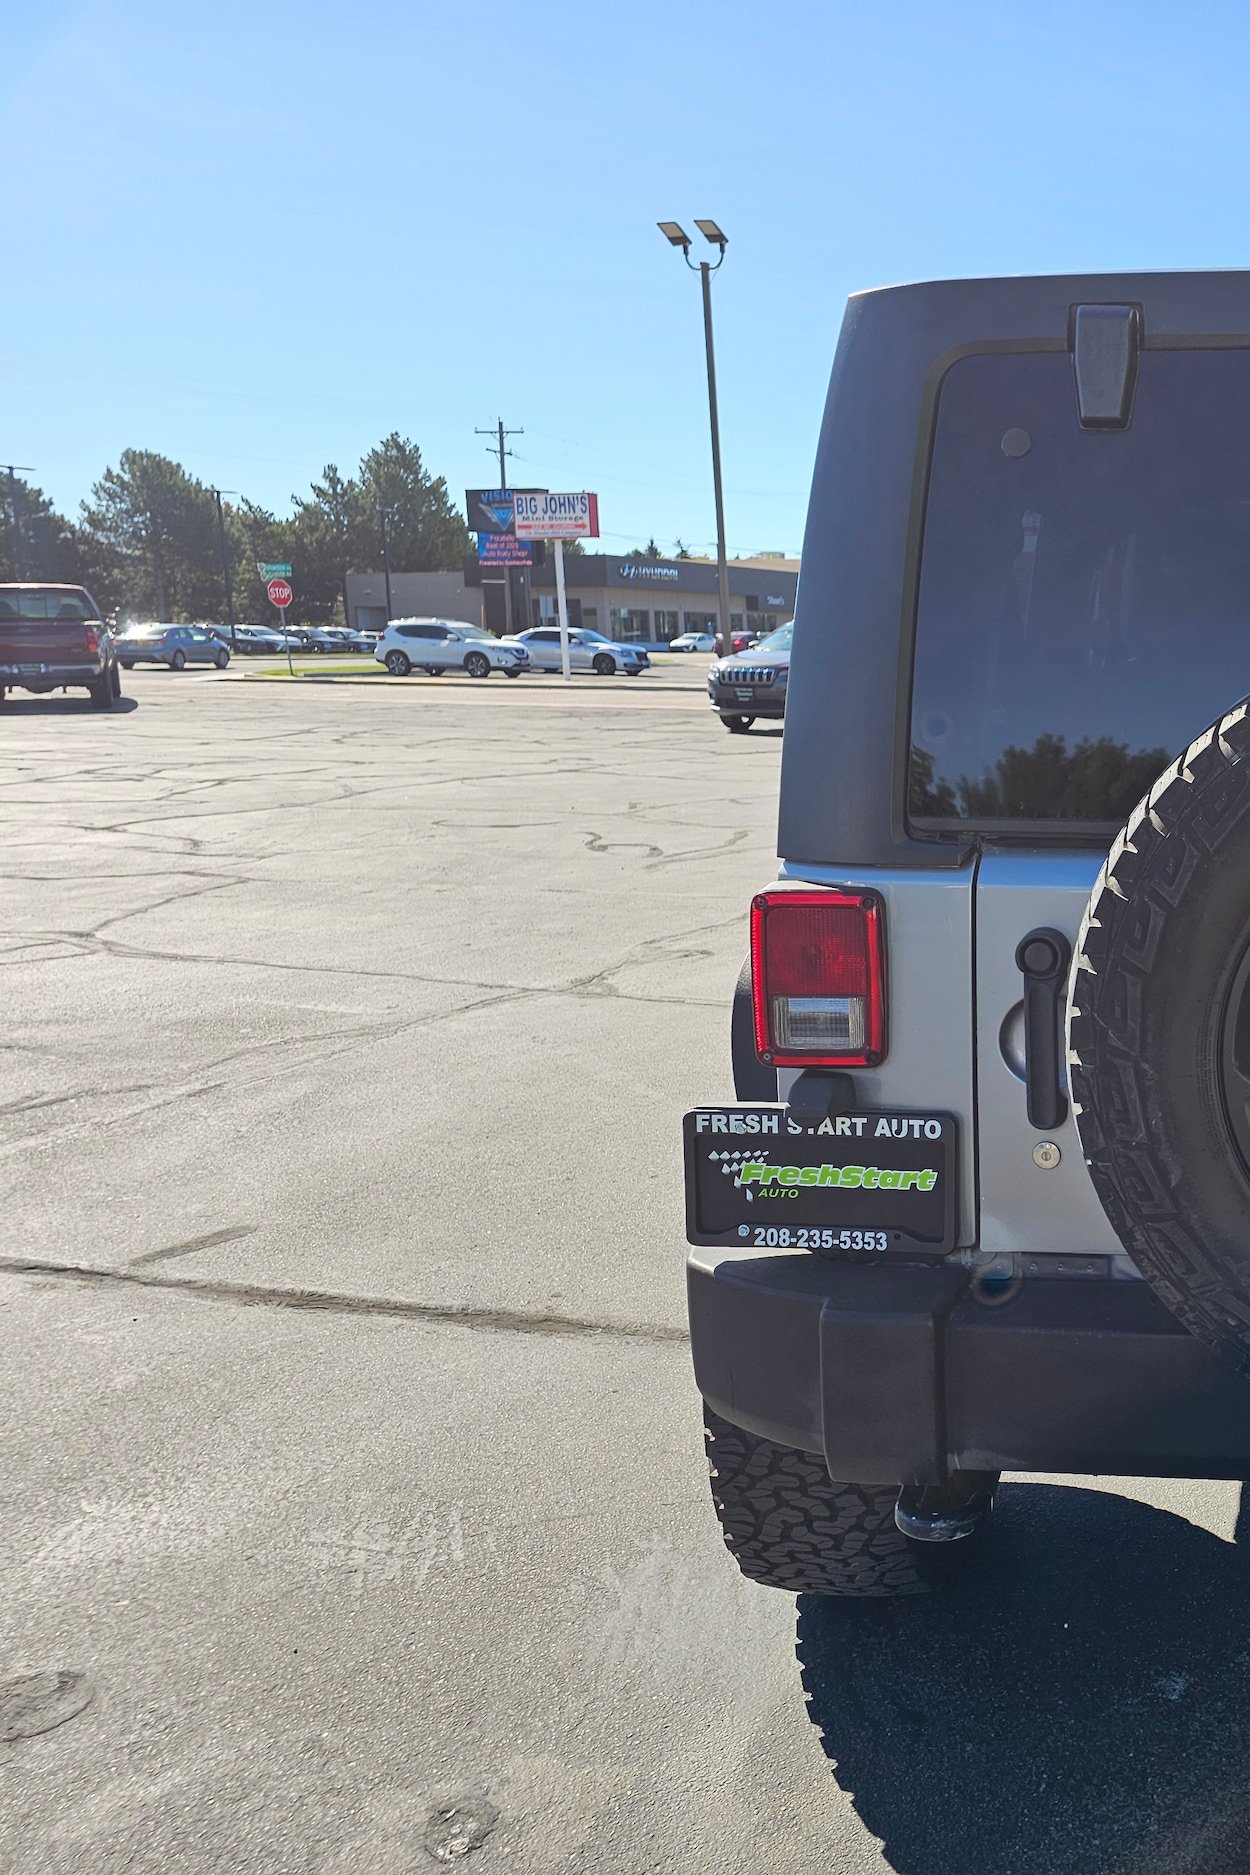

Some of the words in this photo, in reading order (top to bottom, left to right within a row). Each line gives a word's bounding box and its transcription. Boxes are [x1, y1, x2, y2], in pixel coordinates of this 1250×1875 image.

[516, 496, 538, 515] BIG
[543, 495, 588, 514] JOHN'S
[548, 514, 584, 523] Storage
[638, 566, 678, 581] HYUNDAI
[270, 588, 290, 598] STOP
[695, 1114, 779, 1135] FRESH
[787, 1116, 868, 1138] SART
[873, 1117, 943, 1140] AUTO
[739, 1162, 939, 1192] FreshStart
[757, 1187, 800, 1199] AUTO
[753, 1226, 889, 1251] 208-235-5353
